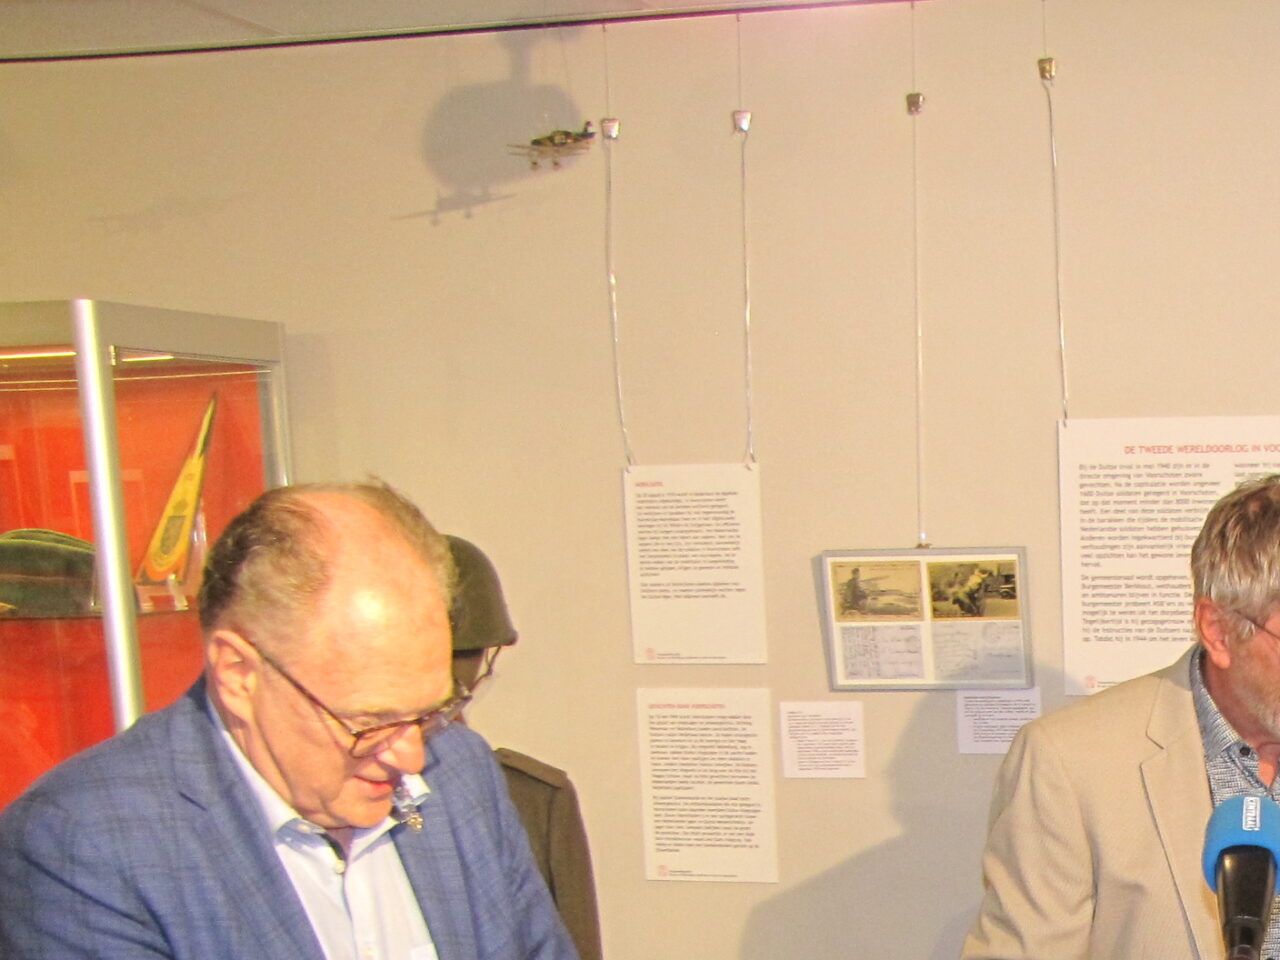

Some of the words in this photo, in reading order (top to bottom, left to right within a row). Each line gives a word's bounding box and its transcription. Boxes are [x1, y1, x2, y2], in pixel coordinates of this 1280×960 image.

[1139, 446, 1173, 454] TWEEDE
[1177, 444, 1249, 453] WERELDOORLOG
[1251, 444, 1261, 452] IN
